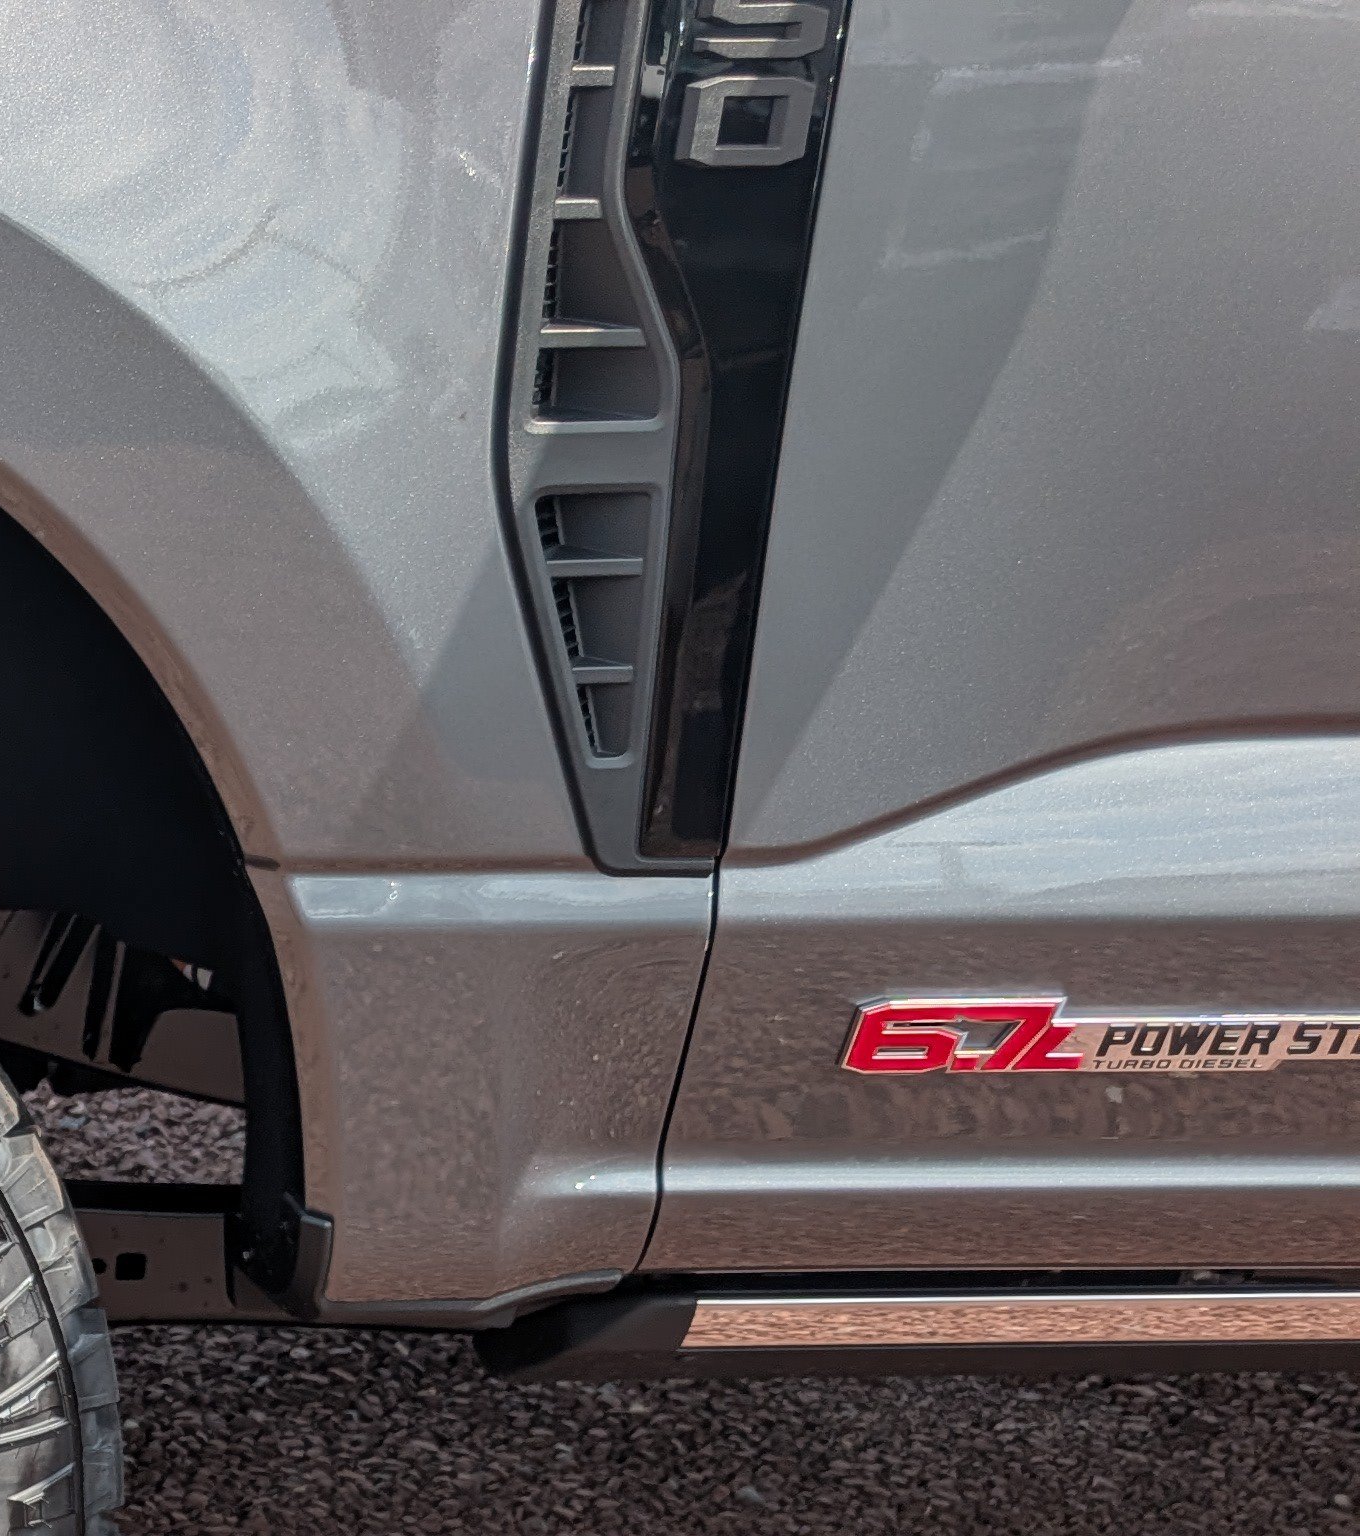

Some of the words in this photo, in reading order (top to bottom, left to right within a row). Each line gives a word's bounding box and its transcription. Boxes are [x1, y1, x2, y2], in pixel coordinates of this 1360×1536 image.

[1095, 1021, 1281, 1057] POWER
[1286, 1021, 1360, 1055] ST
[1092, 1058, 1172, 1070] TURBO
[1178, 1057, 1263, 1070] DIESEL
